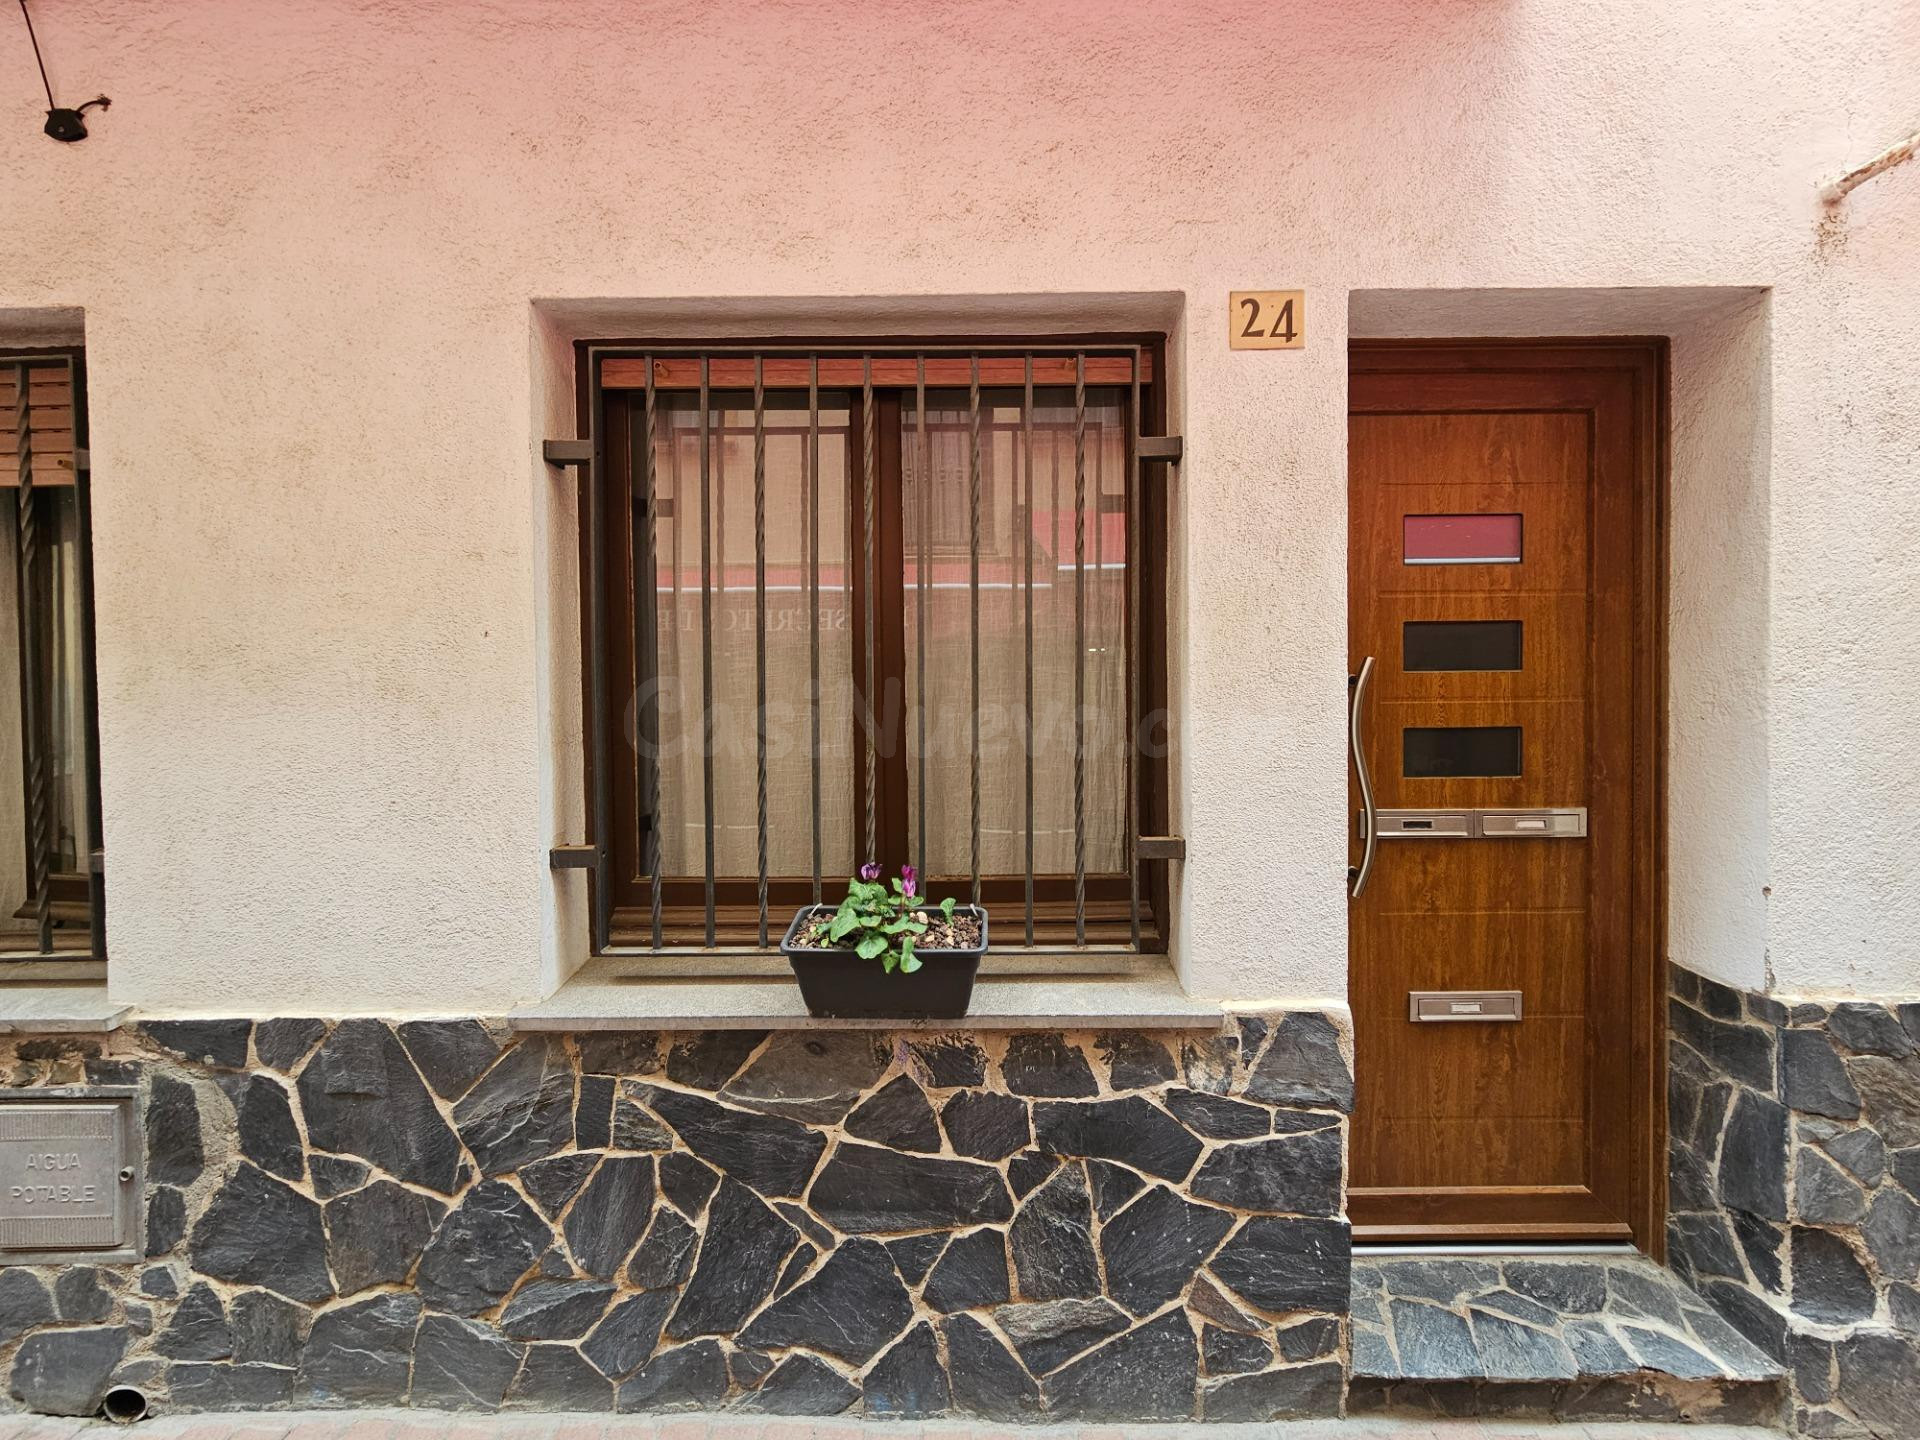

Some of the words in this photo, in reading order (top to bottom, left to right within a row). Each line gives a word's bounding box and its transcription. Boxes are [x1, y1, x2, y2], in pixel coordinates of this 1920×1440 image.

[1240, 298, 1298, 343] 24
[25, 1153, 81, 1170] AIGUA
[10, 1185, 96, 1203] POTABLE
